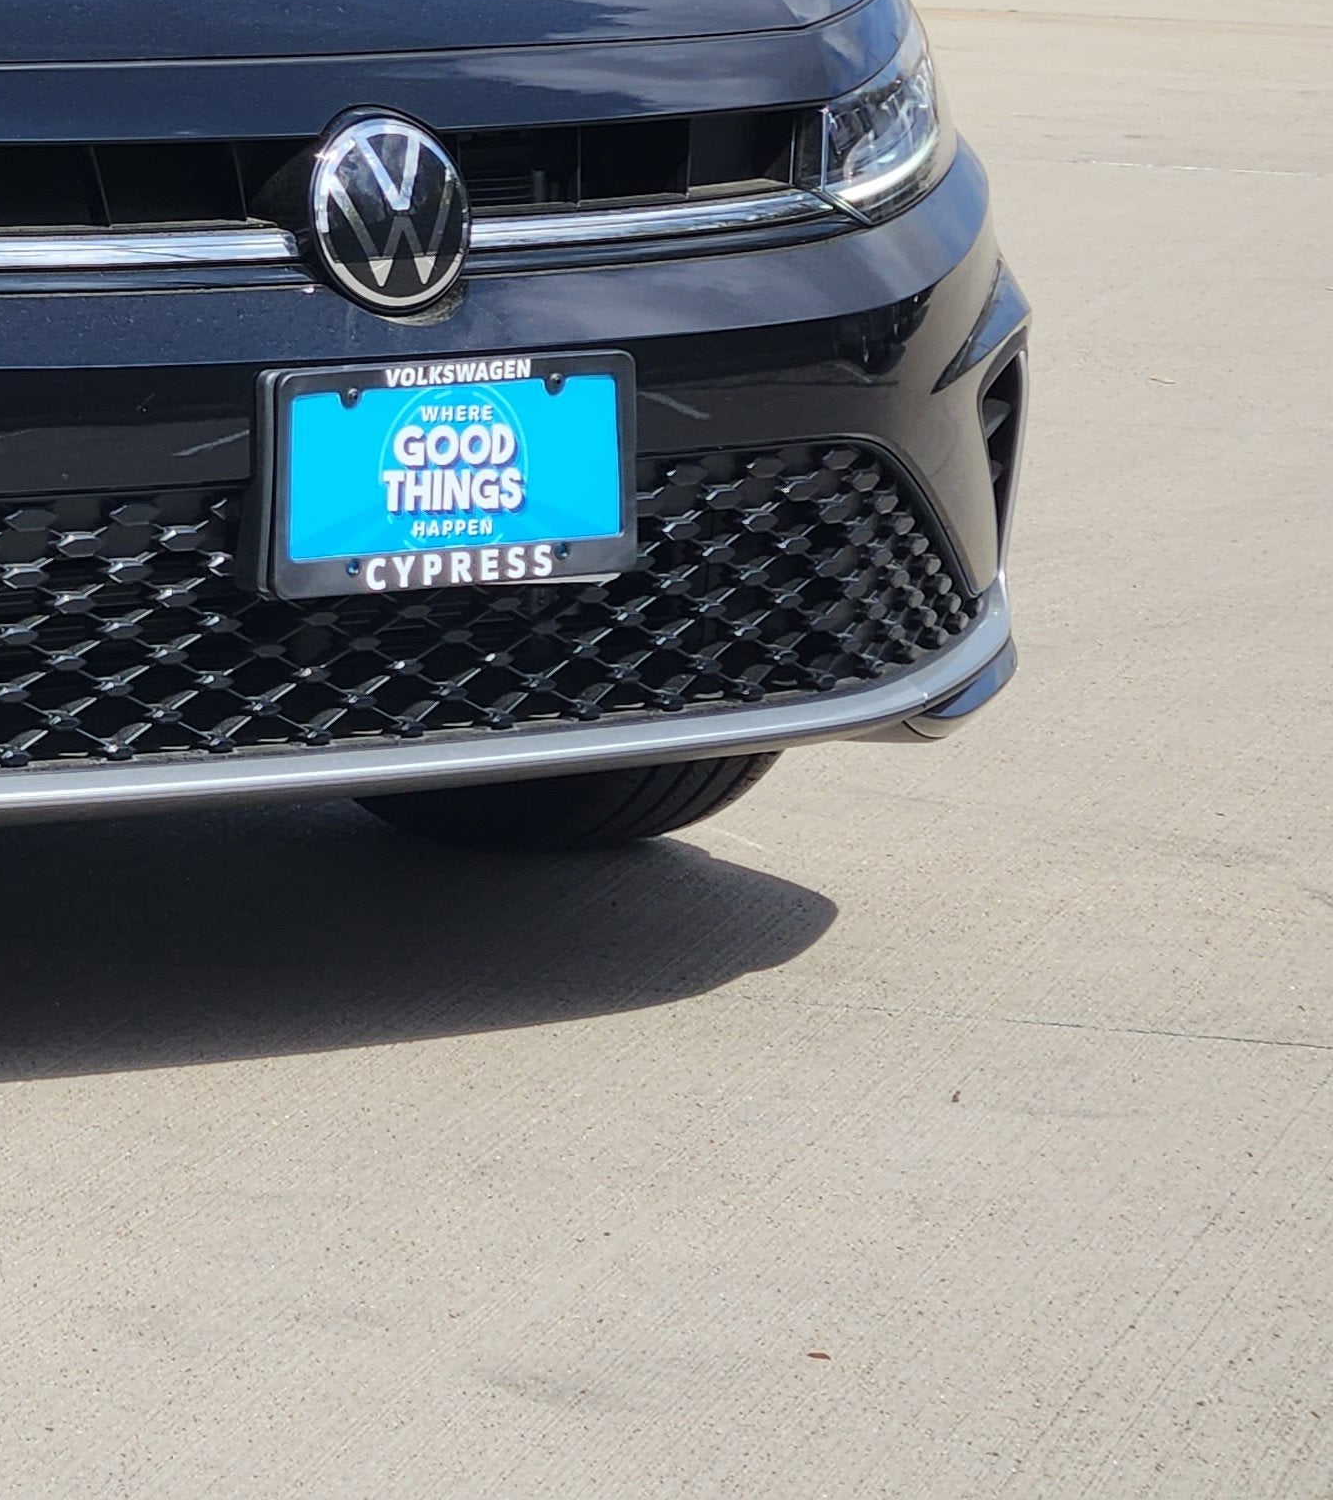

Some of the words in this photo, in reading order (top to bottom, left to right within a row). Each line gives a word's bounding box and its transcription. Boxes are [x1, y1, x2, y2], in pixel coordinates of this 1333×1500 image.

[314, 118, 469, 306] VW
[385, 358, 531, 387] VOLKSWAGEN
[421, 405, 494, 422] WHERE
[393, 424, 517, 466] GOOD
[383, 467, 525, 513] THINGS
[413, 519, 494, 537] HAPPEN
[365, 544, 553, 591] CYPRESS
